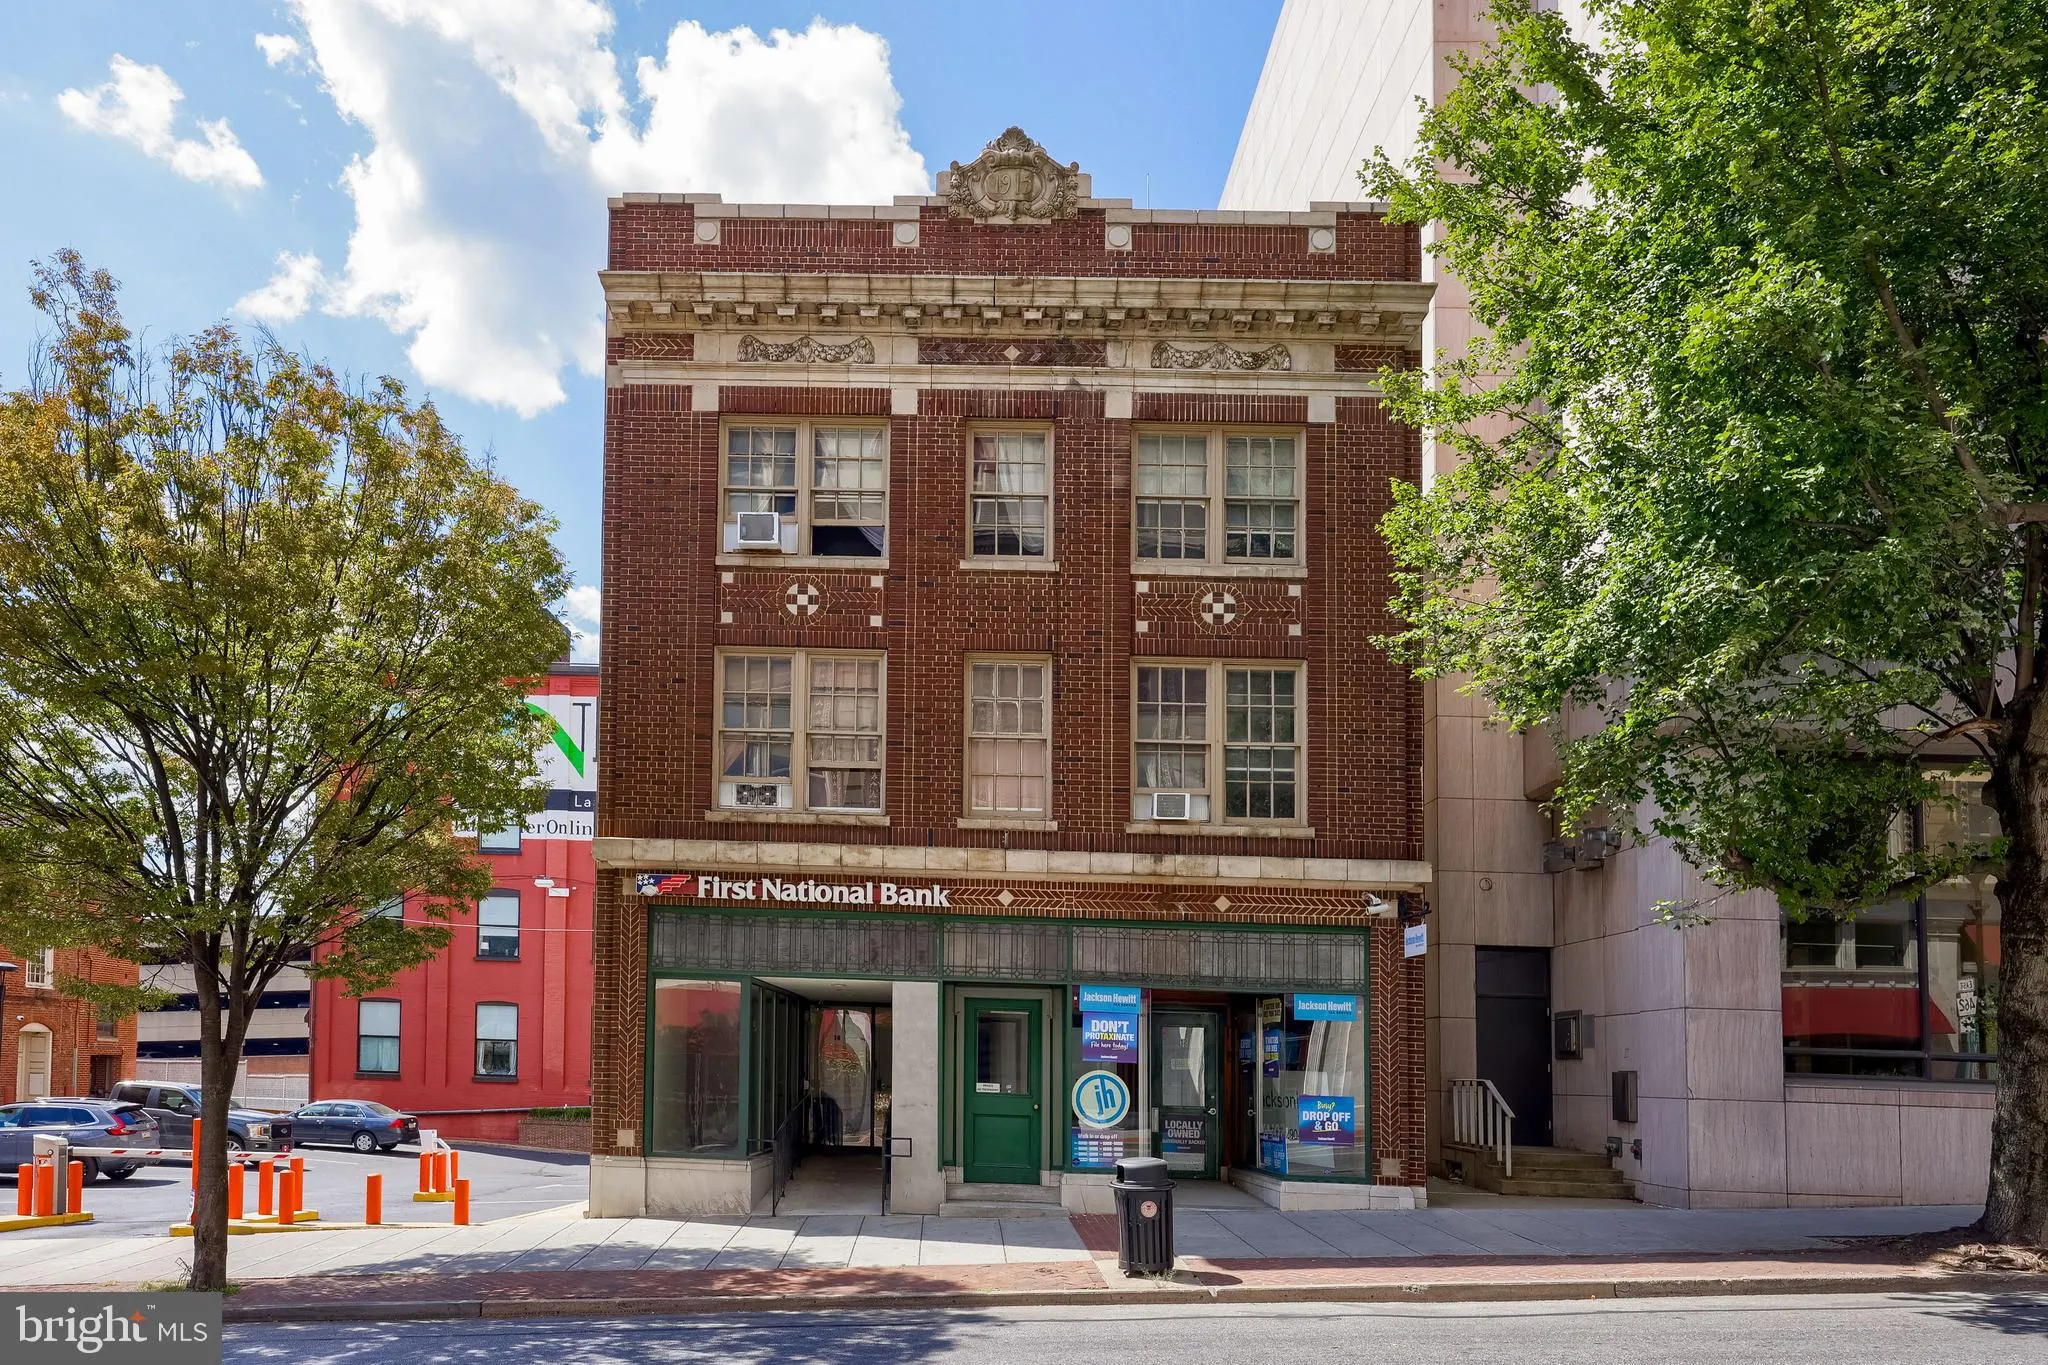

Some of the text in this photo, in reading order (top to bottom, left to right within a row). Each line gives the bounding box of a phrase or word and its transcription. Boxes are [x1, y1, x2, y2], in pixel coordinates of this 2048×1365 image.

[698, 876, 951, 908] First National Bank
[1083, 992, 1136, 1004] Jackson Hewitt
[1298, 1000, 1352, 1012] Jackson Hewitt
[1091, 1020, 1129, 1033] DON'T
[1085, 1032, 1135, 1041] PROTAXINATE
[1112, 1042, 1129, 1051] today!
[1262, 1089, 1298, 1109] ckson
[1317, 1101, 1336, 1112] Busy?
[1302, 1111, 1351, 1122] DROP OFF
[1164, 1120, 1203, 1130] LOCALLY
[1314, 1120, 1339, 1131] & GO
[1167, 1129, 1200, 1138] OWNED
